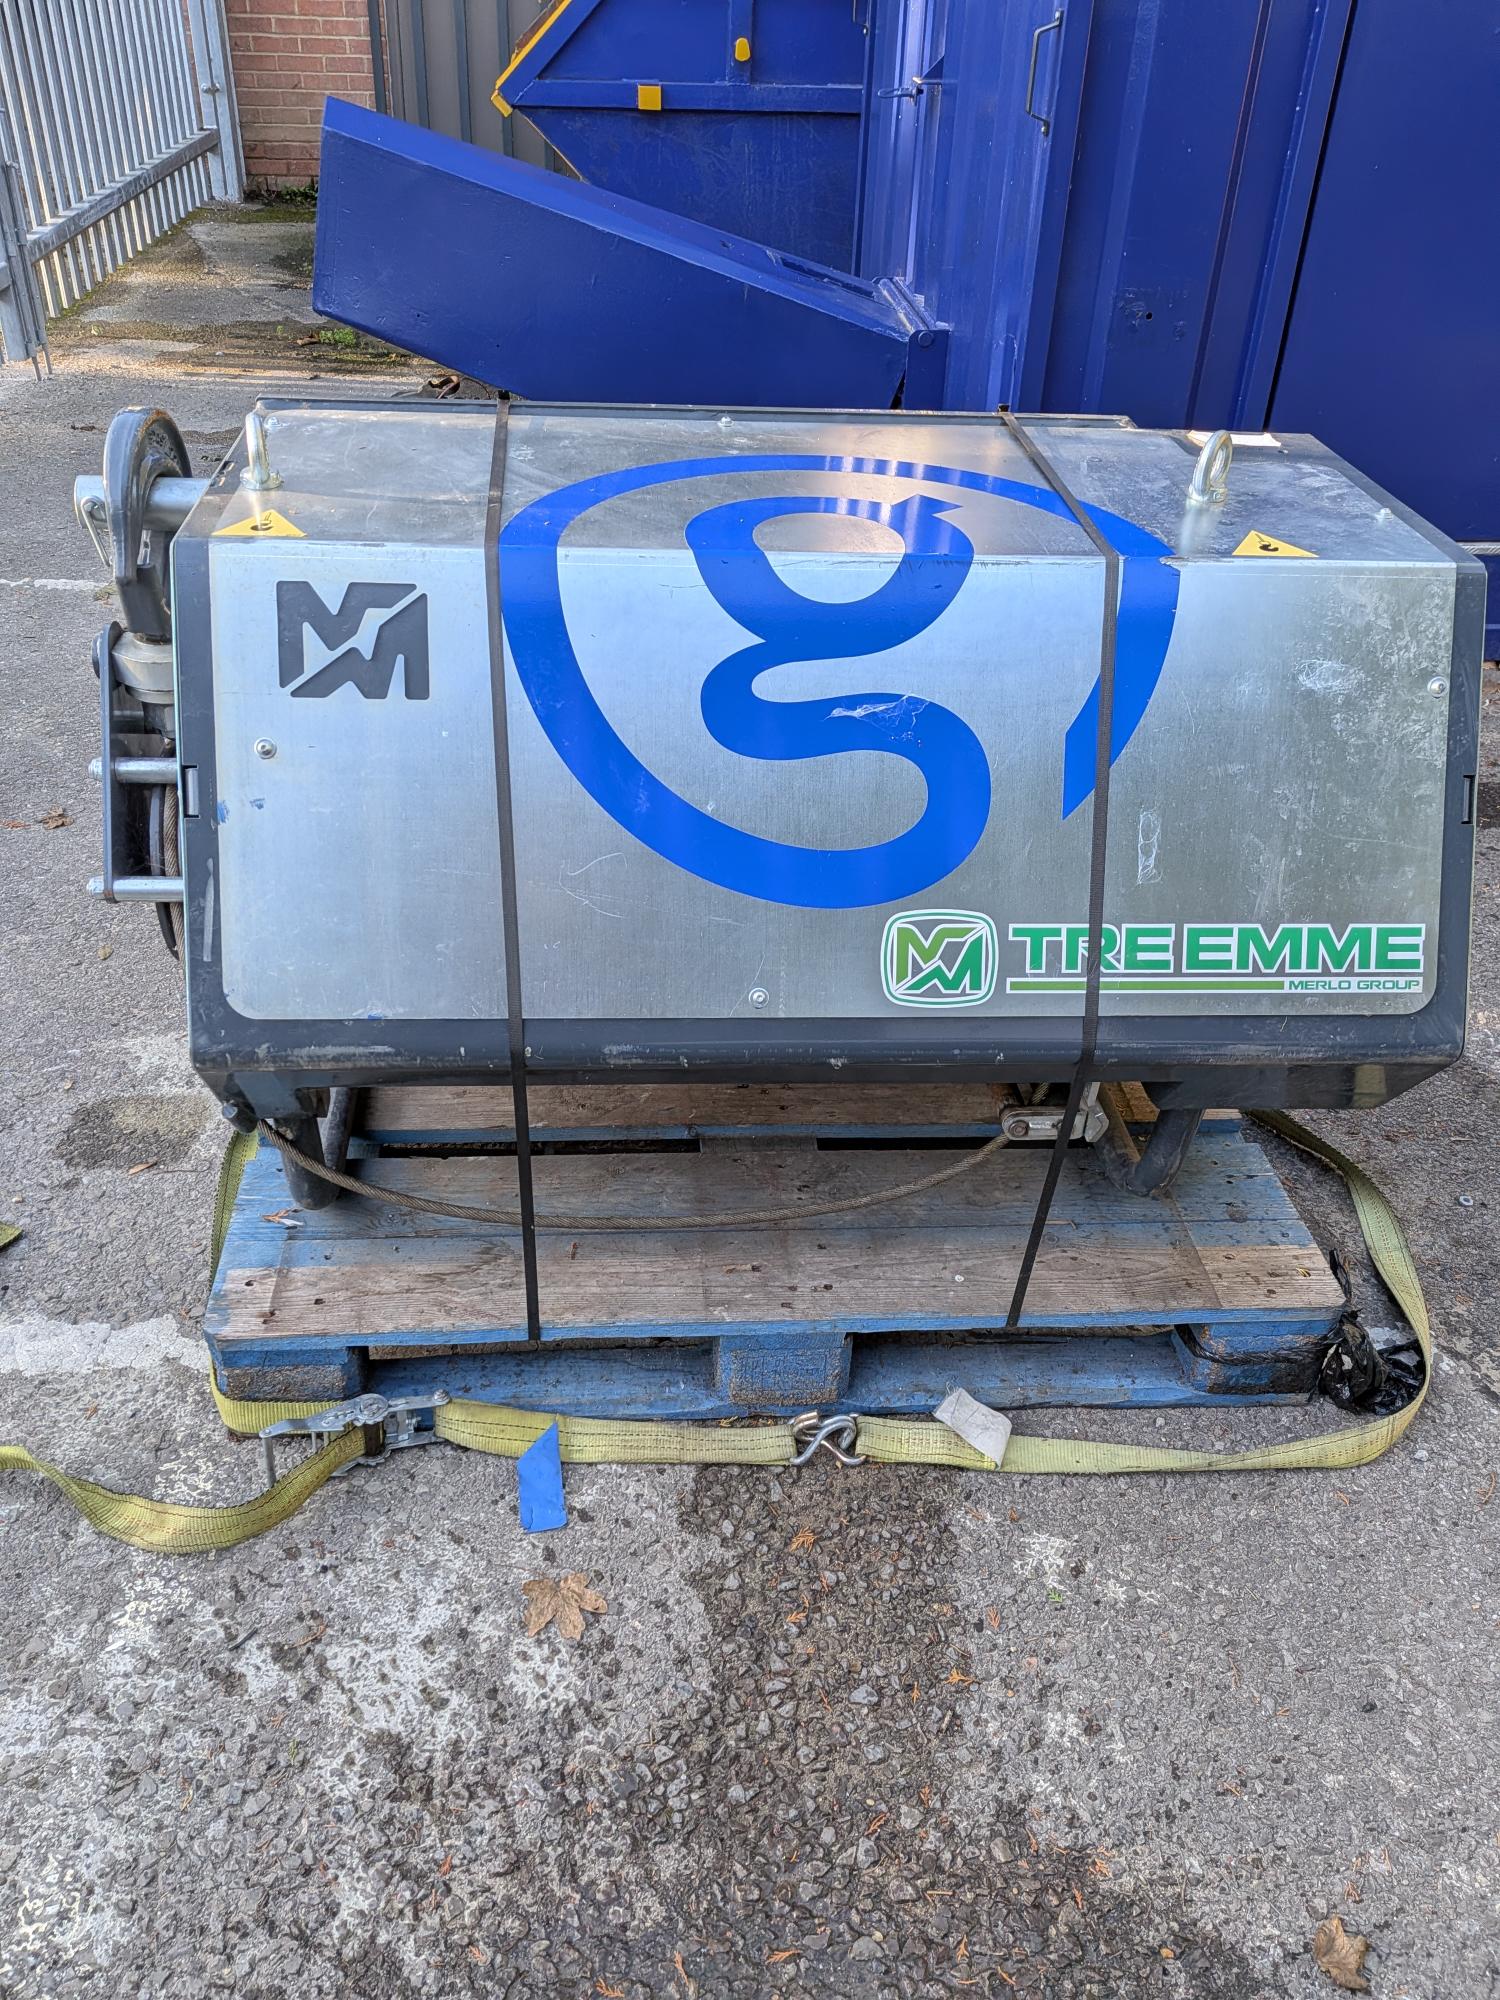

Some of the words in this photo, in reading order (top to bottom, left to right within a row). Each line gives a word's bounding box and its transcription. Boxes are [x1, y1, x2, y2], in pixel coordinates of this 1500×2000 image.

[1183, 924, 1424, 972] EMME
[1288, 979, 1351, 991] MERLO
[1357, 979, 1420, 991] GROUP
